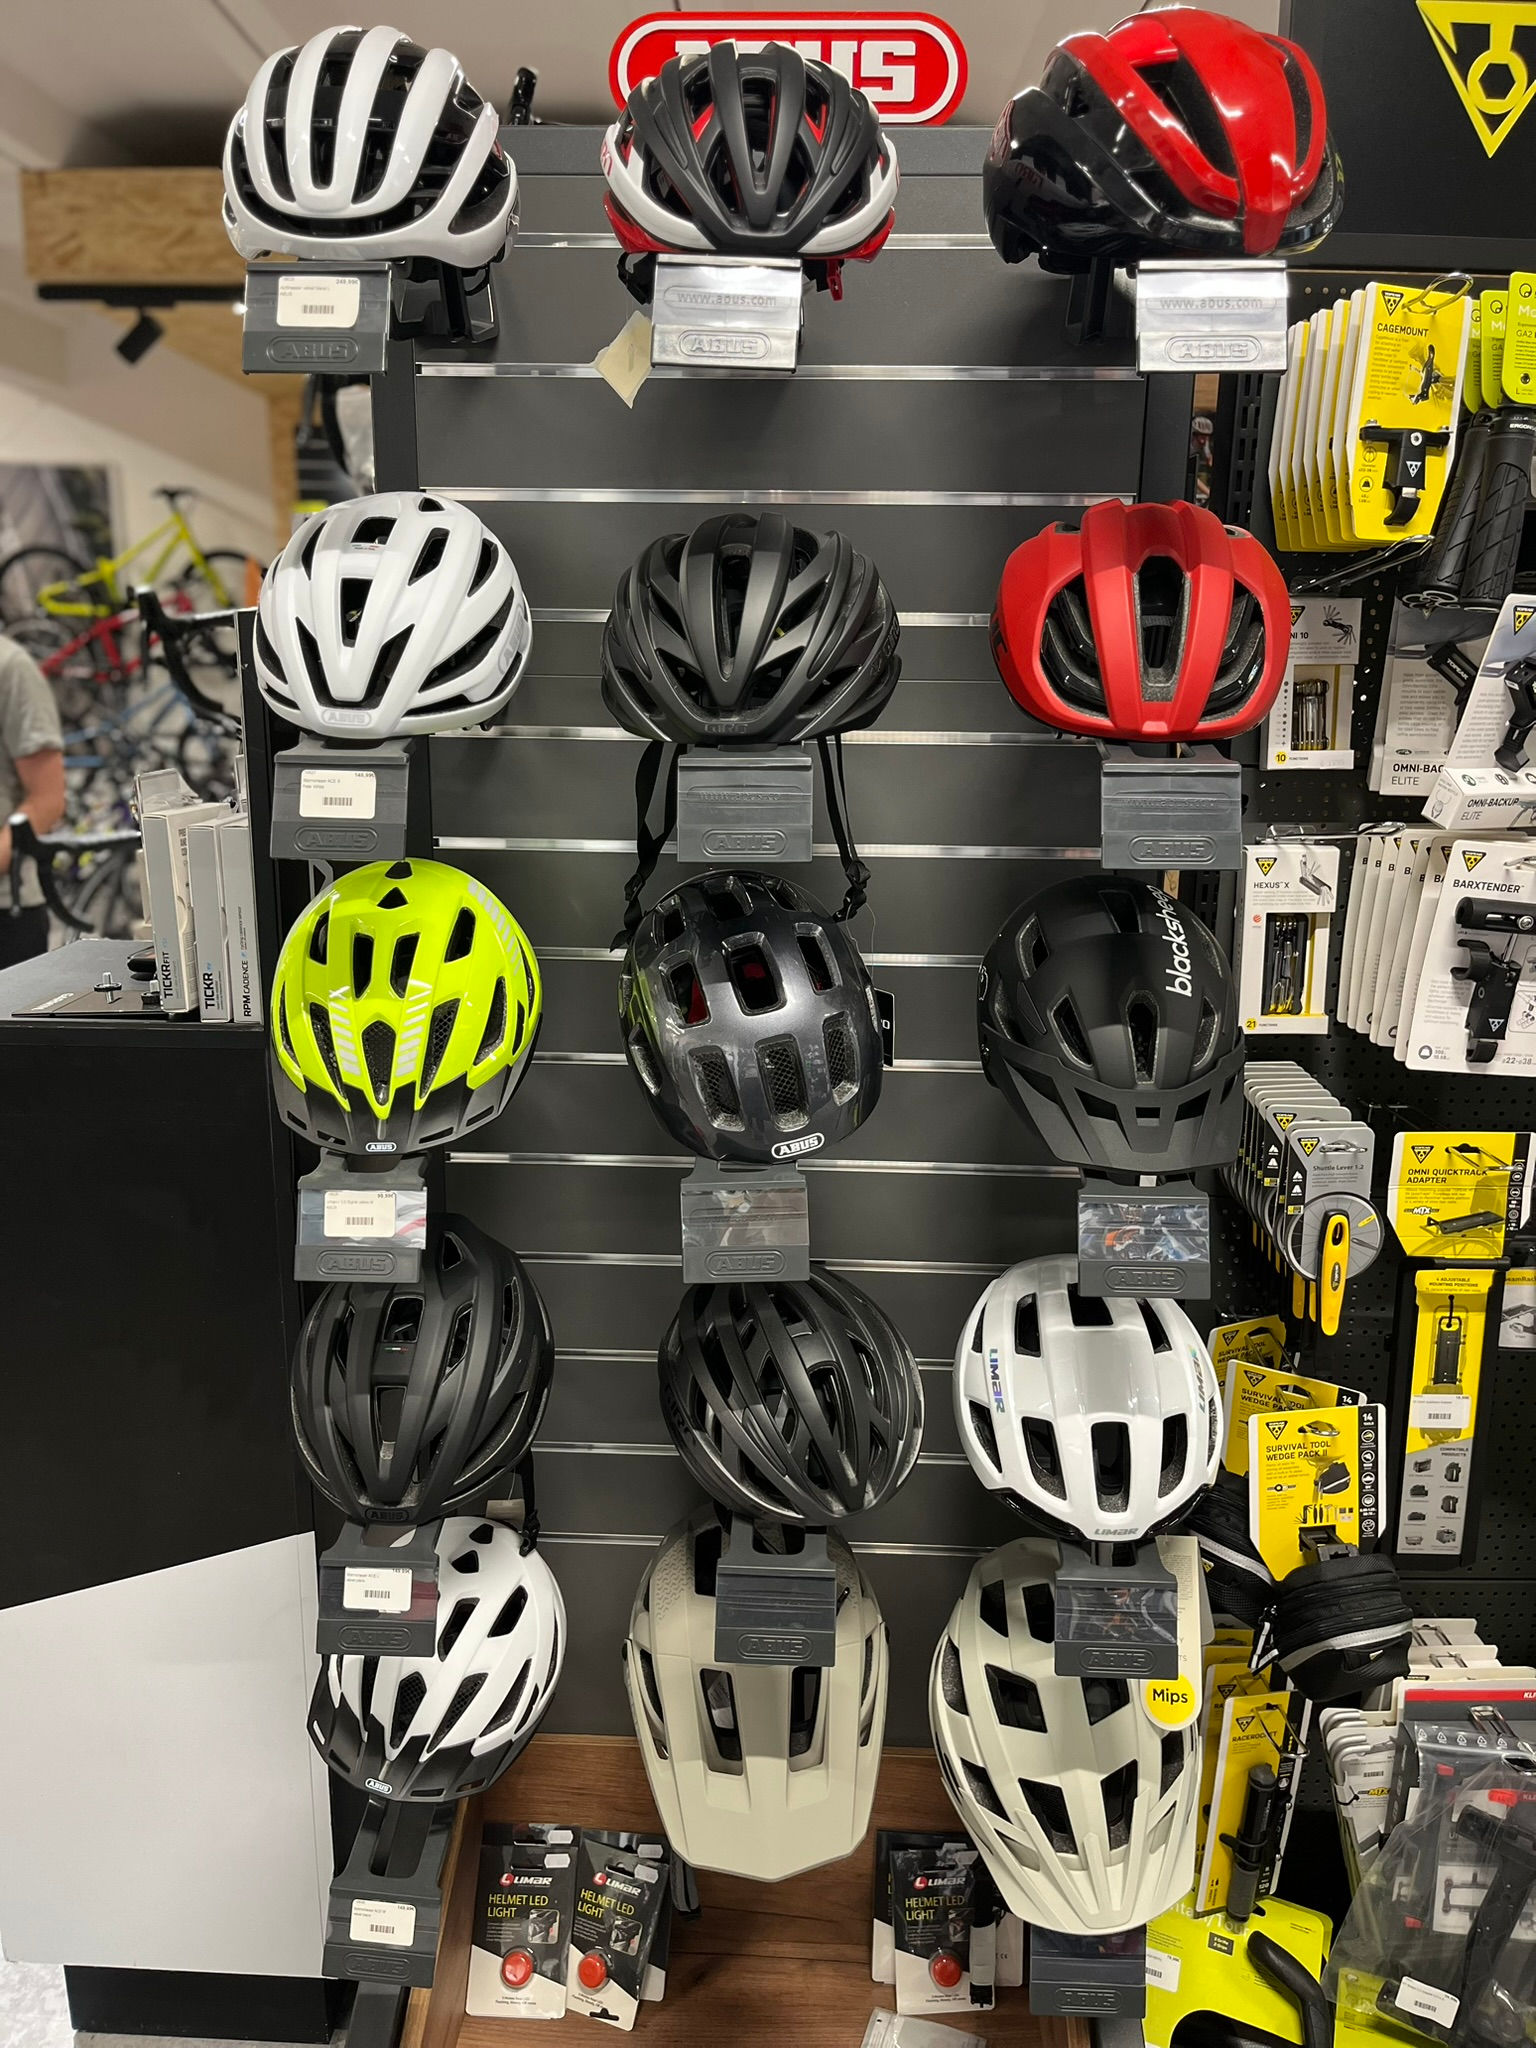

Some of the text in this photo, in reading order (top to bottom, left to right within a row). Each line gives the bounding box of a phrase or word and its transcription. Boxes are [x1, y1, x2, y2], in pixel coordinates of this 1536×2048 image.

[1377, 322, 1429, 337] CAGEMOUNT
[1516, 329, 1533, 338] GA2
[690, 337, 758, 355] ABUS
[1179, 343, 1249, 358] ABUS
[1446, 658, 1469, 681] TOPEAK
[1276, 754, 1287, 763] 10
[1391, 776, 1420, 786] ELITE
[1467, 798, 1519, 808] OMNI-BACKUP
[1461, 811, 1482, 821] ELITE
[1453, 879, 1521, 893] BARXTENDER
[1147, 885, 1192, 998] blacksheep
[161, 964, 174, 999] TICKR
[242, 960, 250, 994] CADENCE
[203, 972, 216, 1010] TICKR
[244, 995, 252, 1017] RPM
[779, 1136, 819, 1156] ABUS
[1408, 1168, 1488, 1176] OMNI QUICKTRACK
[1407, 1176, 1447, 1184] ADAPTER
[1412, 1206, 1431, 1215] MTX
[1240, 1395, 1270, 1408] WEDGE
[1241, 1388, 1283, 1404] SURVIVAL
[1342, 1395, 1353, 1404] 14
[1362, 1412, 1373, 1422] 14
[1266, 1440, 1331, 1453] SURVIVAL TOOL
[1266, 1451, 1295, 1461] WEDGE
[1298, 1449, 1320, 1458] PACK
[1152, 1688, 1188, 1705] Mips
[369, 1780, 389, 1792] ABUS
[488, 1893, 549, 1906] HELMET LED
[580, 1888, 635, 1915] HELMET LED
[905, 1895, 965, 1908] HELMET LED
[487, 1907, 517, 1918] LIGHT
[577, 1900, 605, 1918] LIGHT
[905, 1909, 935, 1921] LIGHT
